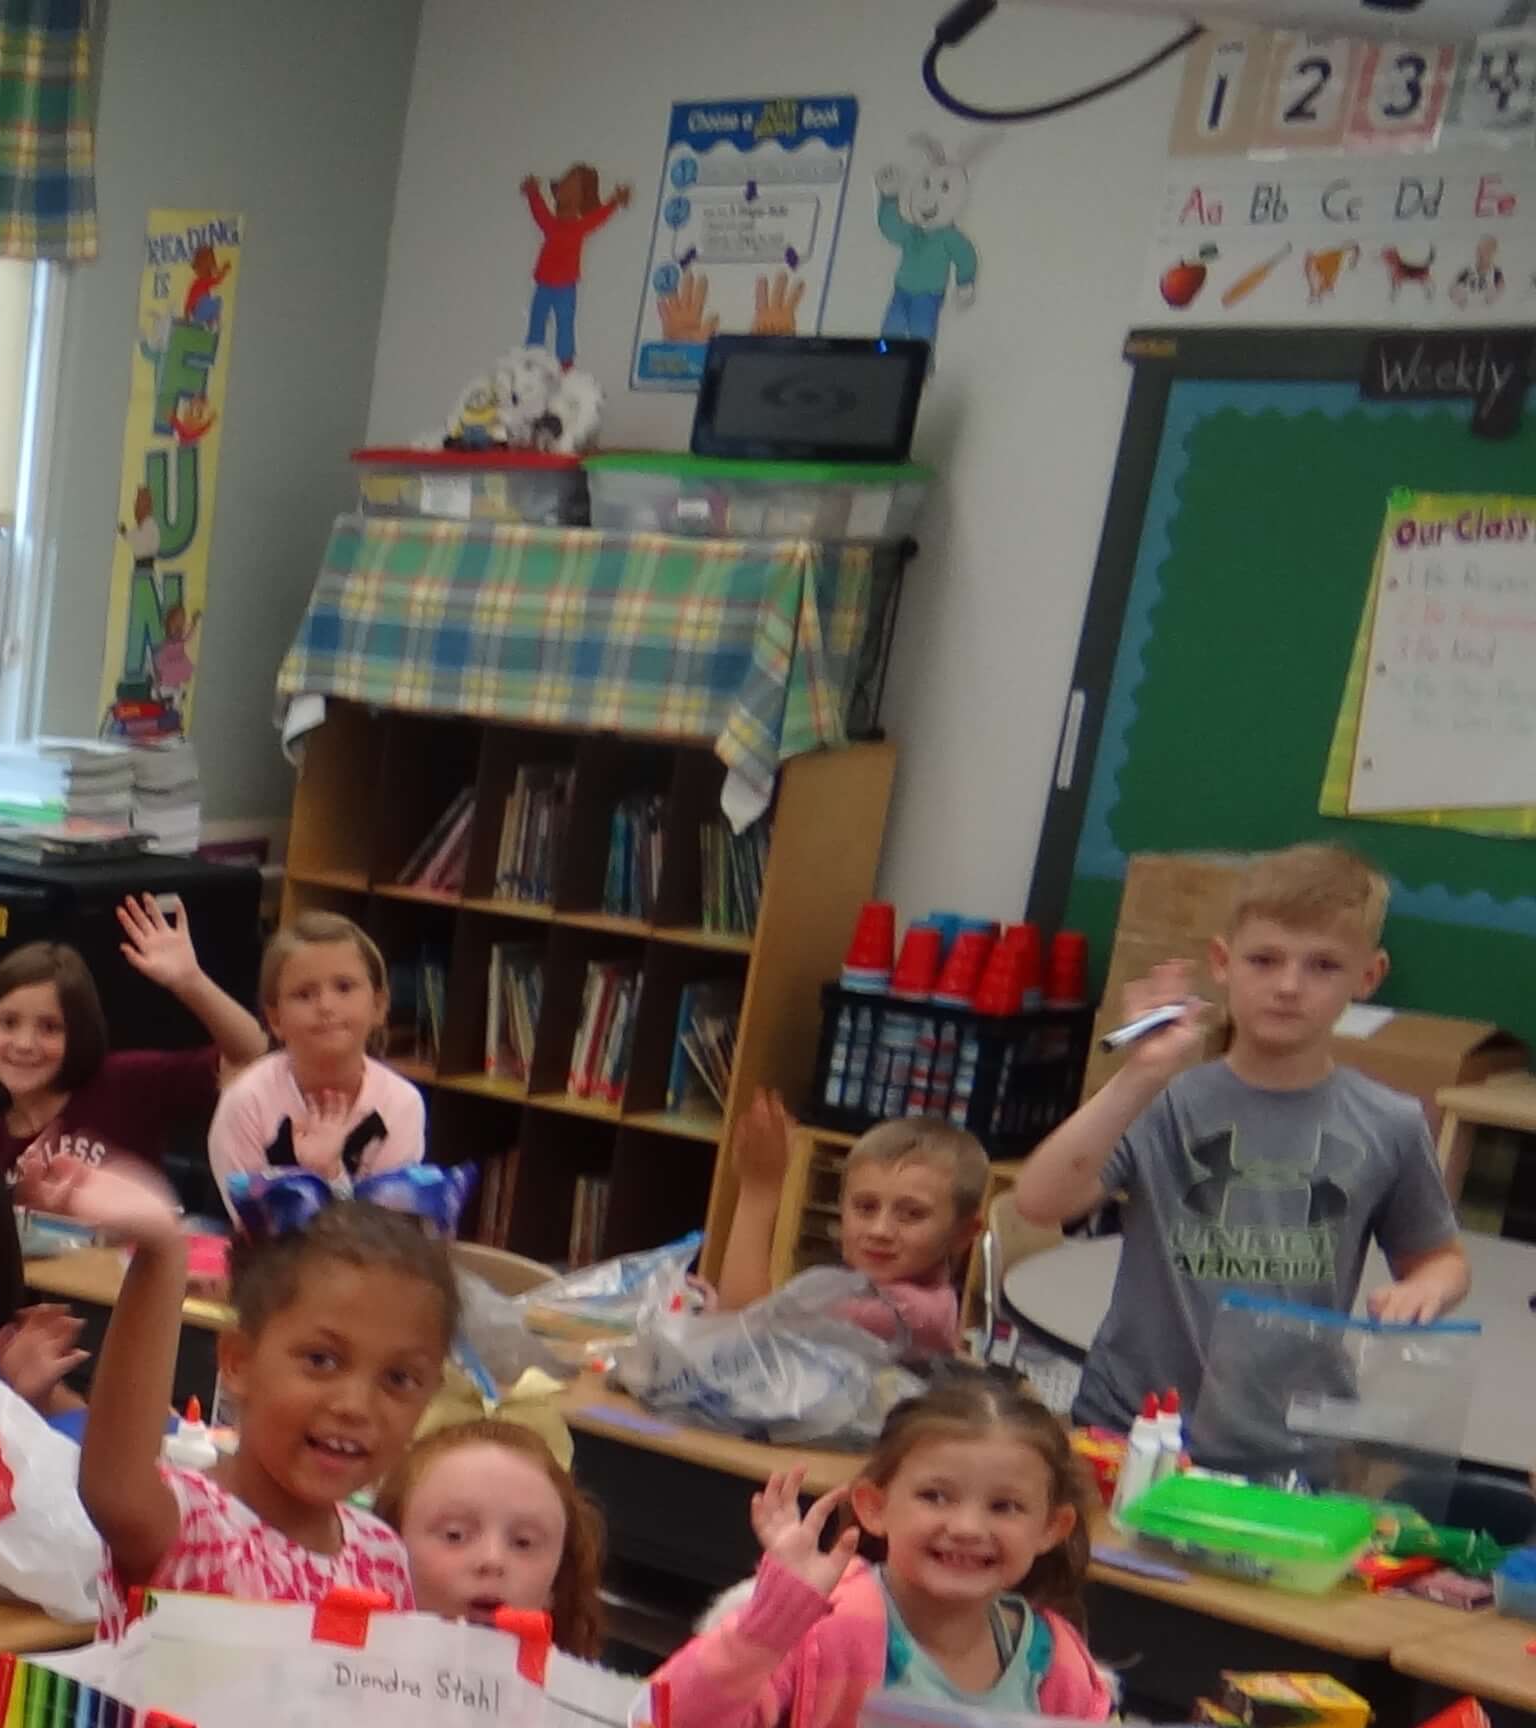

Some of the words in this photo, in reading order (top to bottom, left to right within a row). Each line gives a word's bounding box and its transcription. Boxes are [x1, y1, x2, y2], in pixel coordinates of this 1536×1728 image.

[1206, 72, 1229, 129] 1
[1282, 55, 1334, 123] 2
[1381, 52, 1428, 117] 3
[1178, 184, 1225, 227] Aa
[1248, 181, 1293, 227] Bb
[1320, 177, 1364, 223] Cc
[1393, 174, 1447, 220] Dd
[1473, 172, 1521, 220] Ee
[144, 217, 242, 268] READING
[151, 272, 173, 301] IS
[1377, 342, 1518, 419] Weekly
[1394, 517, 1448, 549] Our
